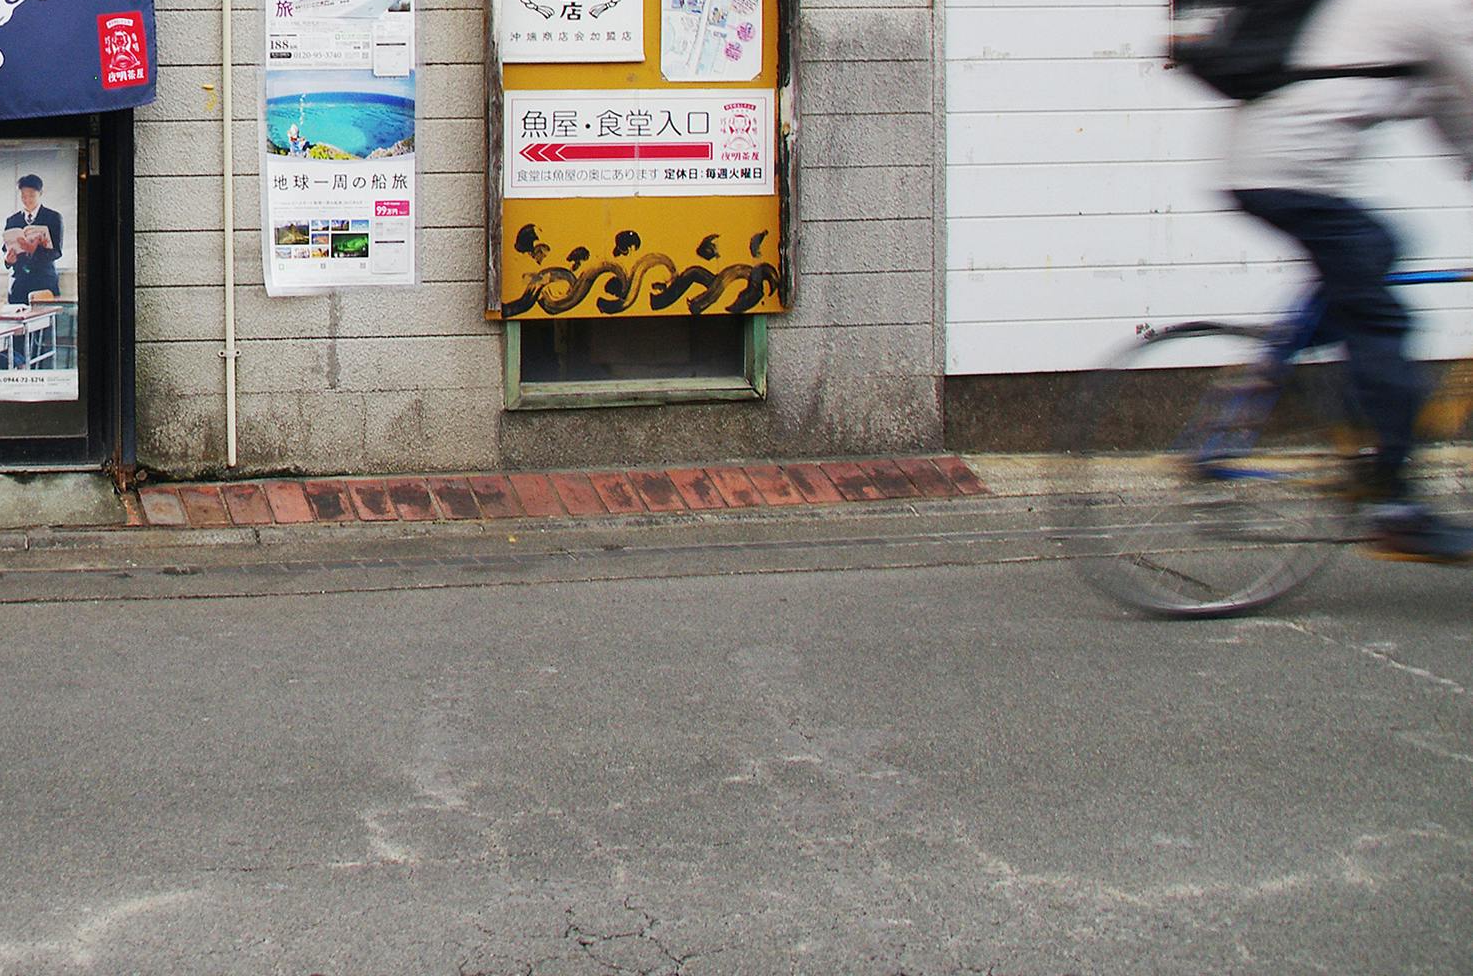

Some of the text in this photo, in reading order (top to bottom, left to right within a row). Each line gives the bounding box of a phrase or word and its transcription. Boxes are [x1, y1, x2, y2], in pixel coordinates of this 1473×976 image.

[521, 109, 710, 138] 魚屋・食堂入口
[273, 174, 408, 191] 地球一周の船旅
[516, 168, 659, 182] 食堂は魚屋の奥にあります
